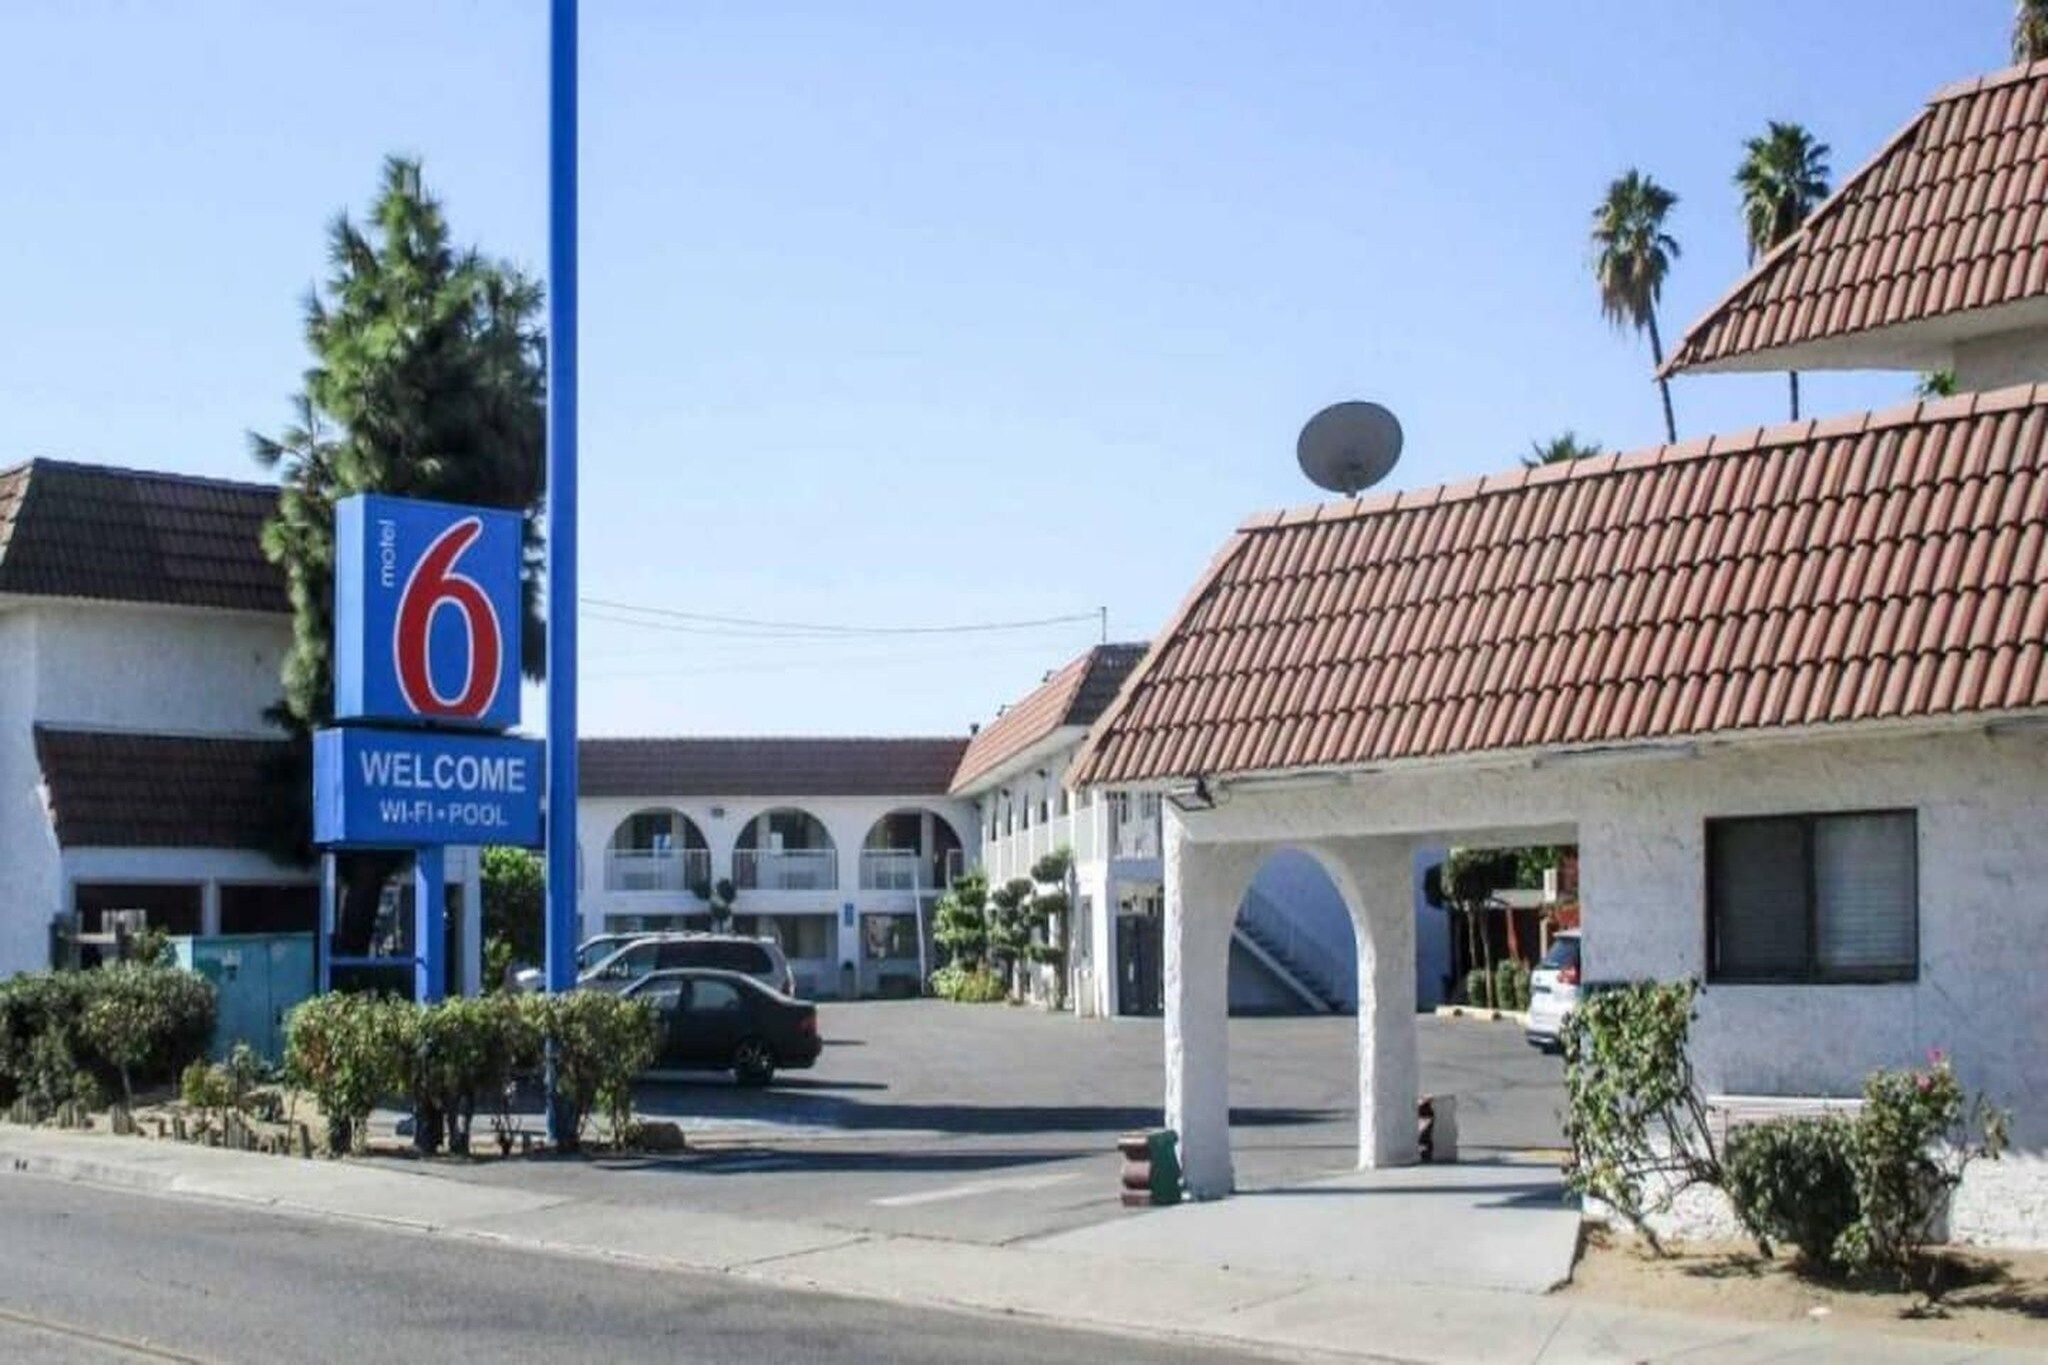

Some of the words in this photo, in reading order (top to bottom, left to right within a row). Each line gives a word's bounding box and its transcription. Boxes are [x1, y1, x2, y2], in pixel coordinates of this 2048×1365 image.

[379, 519, 396, 588] motel
[393, 516, 502, 720] 6
[361, 750, 527, 792] WELCOME
[449, 803, 508, 827] POOL
